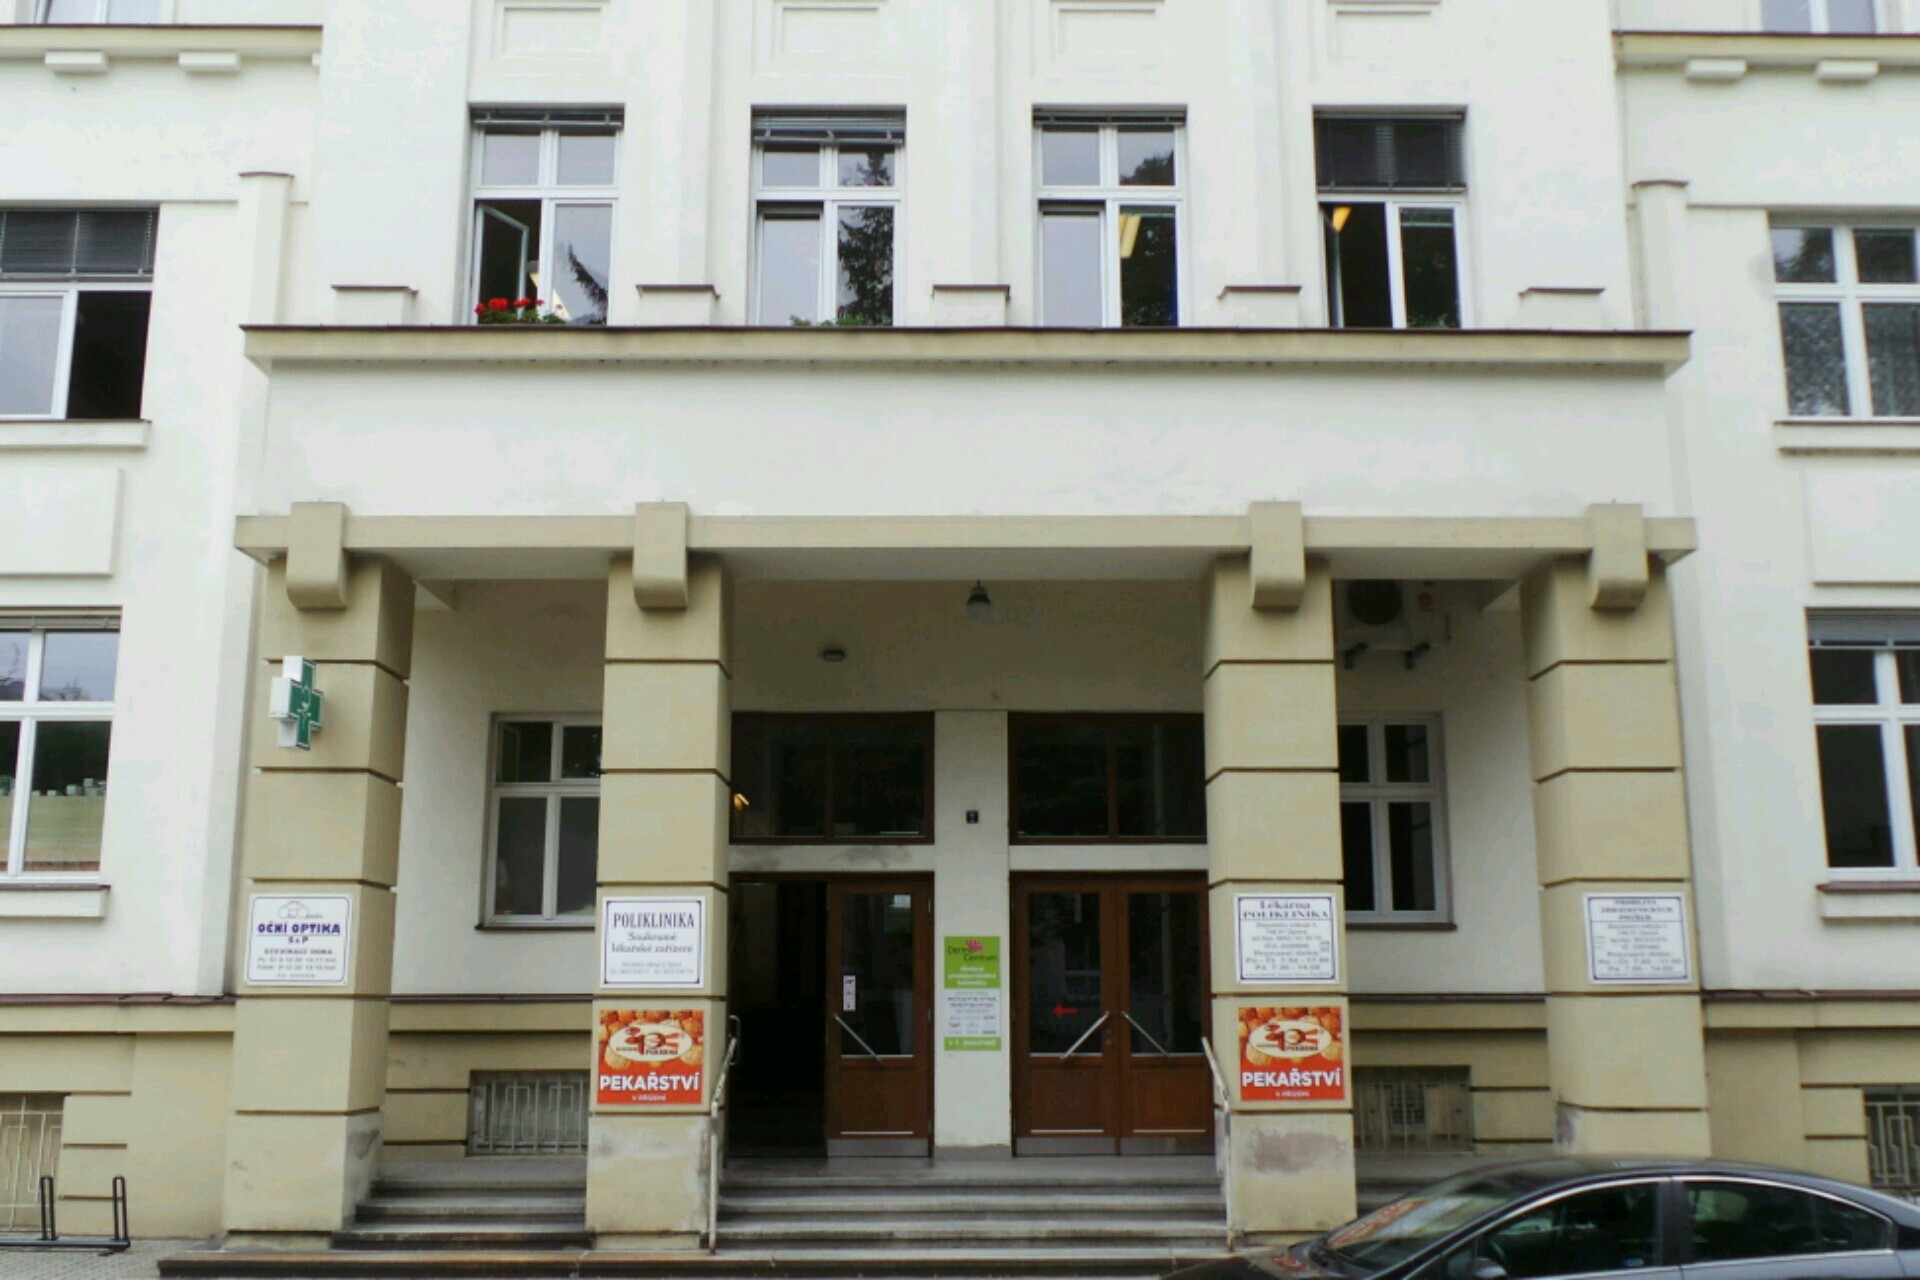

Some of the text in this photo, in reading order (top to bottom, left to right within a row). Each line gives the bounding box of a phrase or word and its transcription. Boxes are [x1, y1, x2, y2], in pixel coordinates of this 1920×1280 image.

[257, 920, 341, 933] OČNÍ OPTIKA
[613, 911, 695, 928] POLIKLINIKA
[611, 942, 694, 953] lékařské zařízení
[600, 1072, 700, 1091] PEKAŘSTVÍ
[1242, 1067, 1341, 1087] PEKAŘSTVÍ
